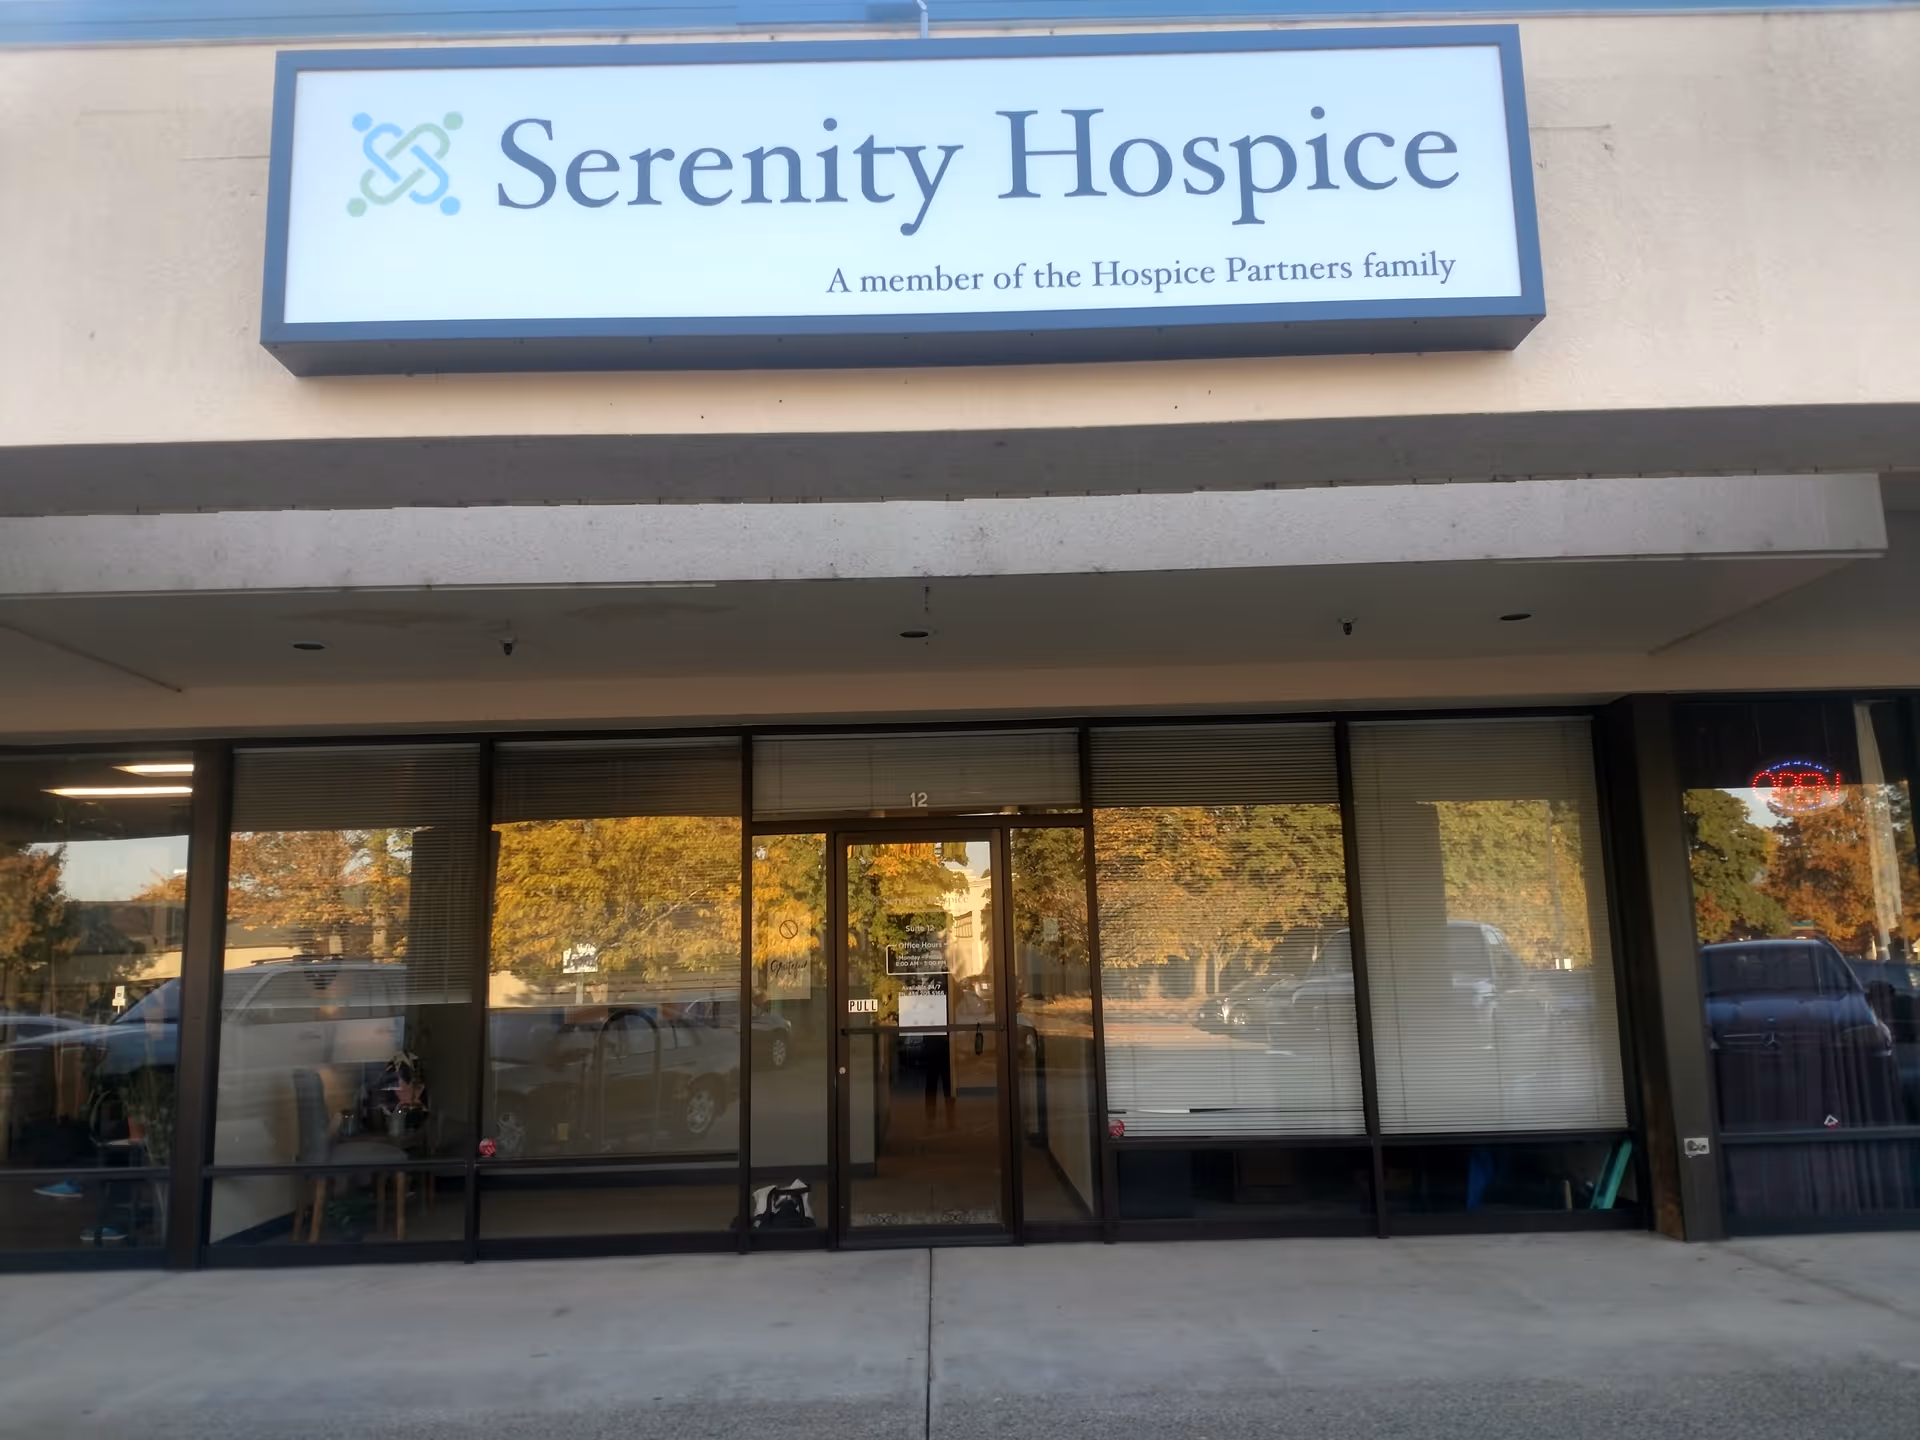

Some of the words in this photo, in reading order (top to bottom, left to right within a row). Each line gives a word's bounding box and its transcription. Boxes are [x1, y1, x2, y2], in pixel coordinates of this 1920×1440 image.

[498, 118, 963, 236] Serenity
[996, 106, 1459, 225] Hospice
[826, 267, 852, 293] A
[861, 264, 984, 293] member
[993, 262, 1027, 290] of
[1033, 261, 1081, 289] the
[1091, 260, 1215, 294] Hospice
[1225, 257, 1353, 282] Partners
[1363, 250, 1457, 285] family
[1752, 771, 1841, 803] OPEN
[910, 792, 928, 808] 12
[927, 895, 969, 906] Hpice
[849, 1000, 877, 1011] PULL
